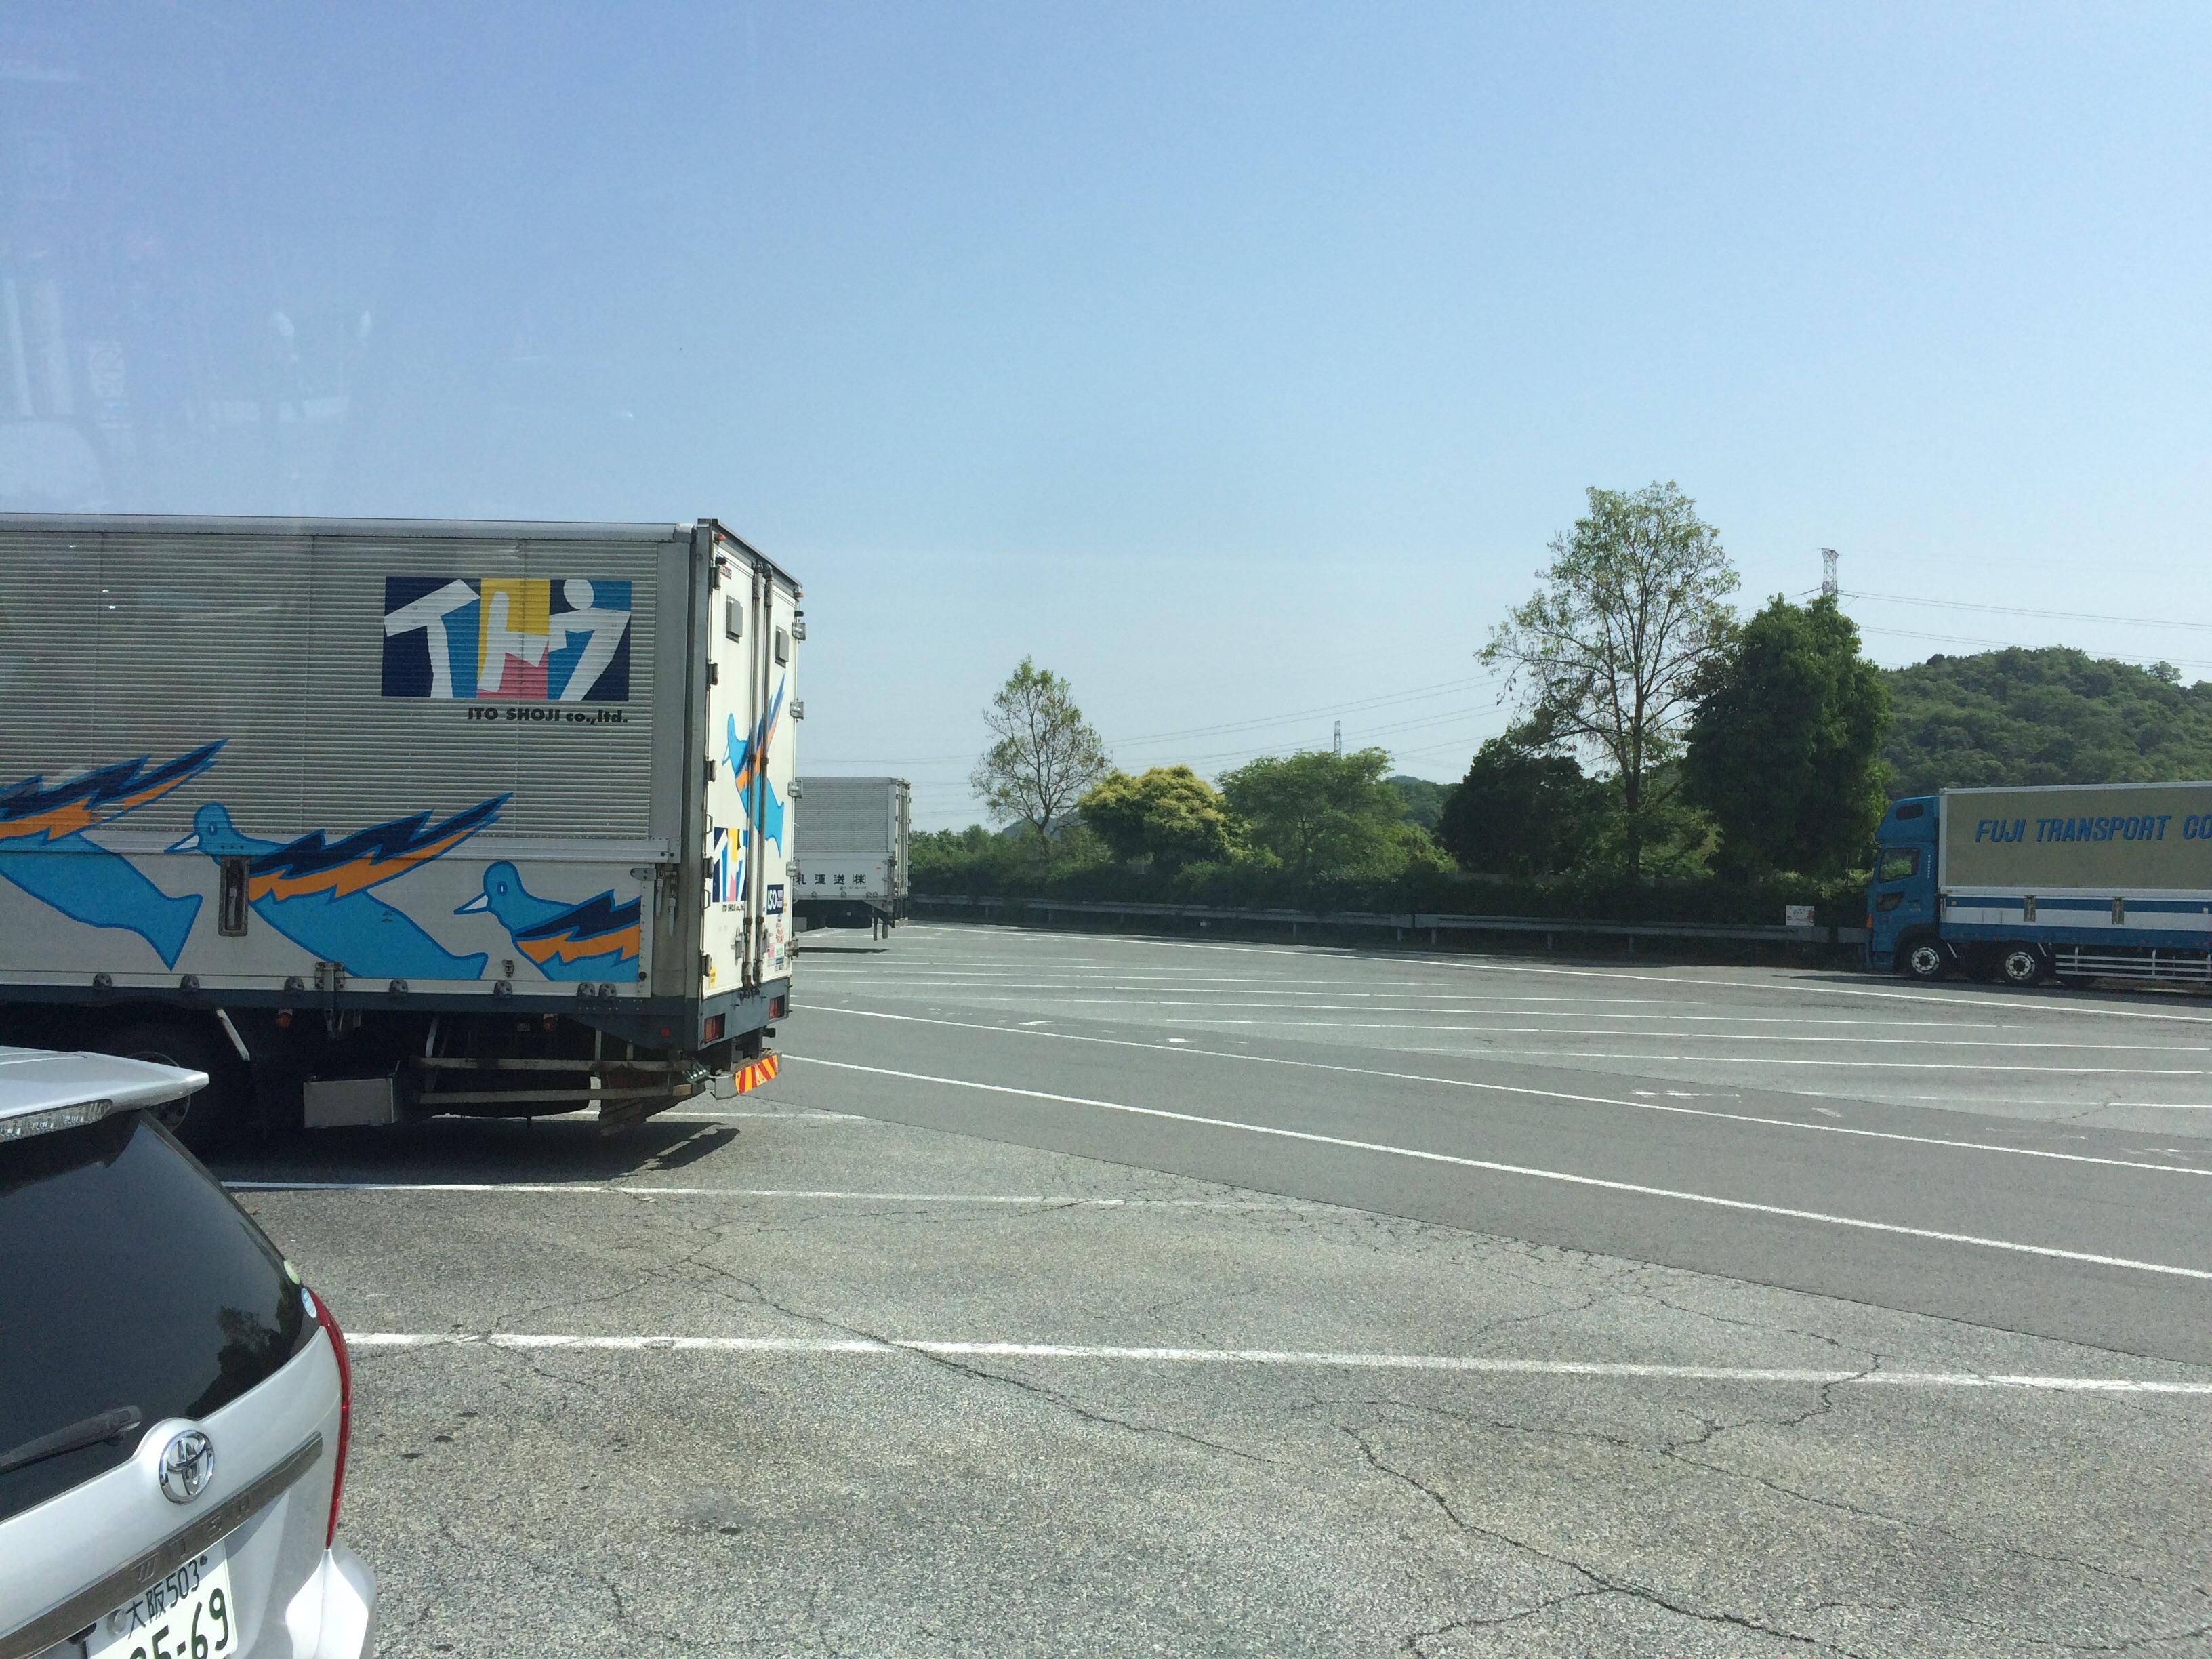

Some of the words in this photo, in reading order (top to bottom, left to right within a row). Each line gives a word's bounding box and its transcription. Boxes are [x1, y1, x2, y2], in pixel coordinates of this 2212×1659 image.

[468, 707, 499, 720] ITO
[506, 708, 560, 722] SHOJI
[1975, 819, 2026, 843] FUJI
[2036, 815, 2171, 842] TRANSPORT
[767, 889, 777, 911] ISO
[130, 1587, 229, 1659] 5-69
